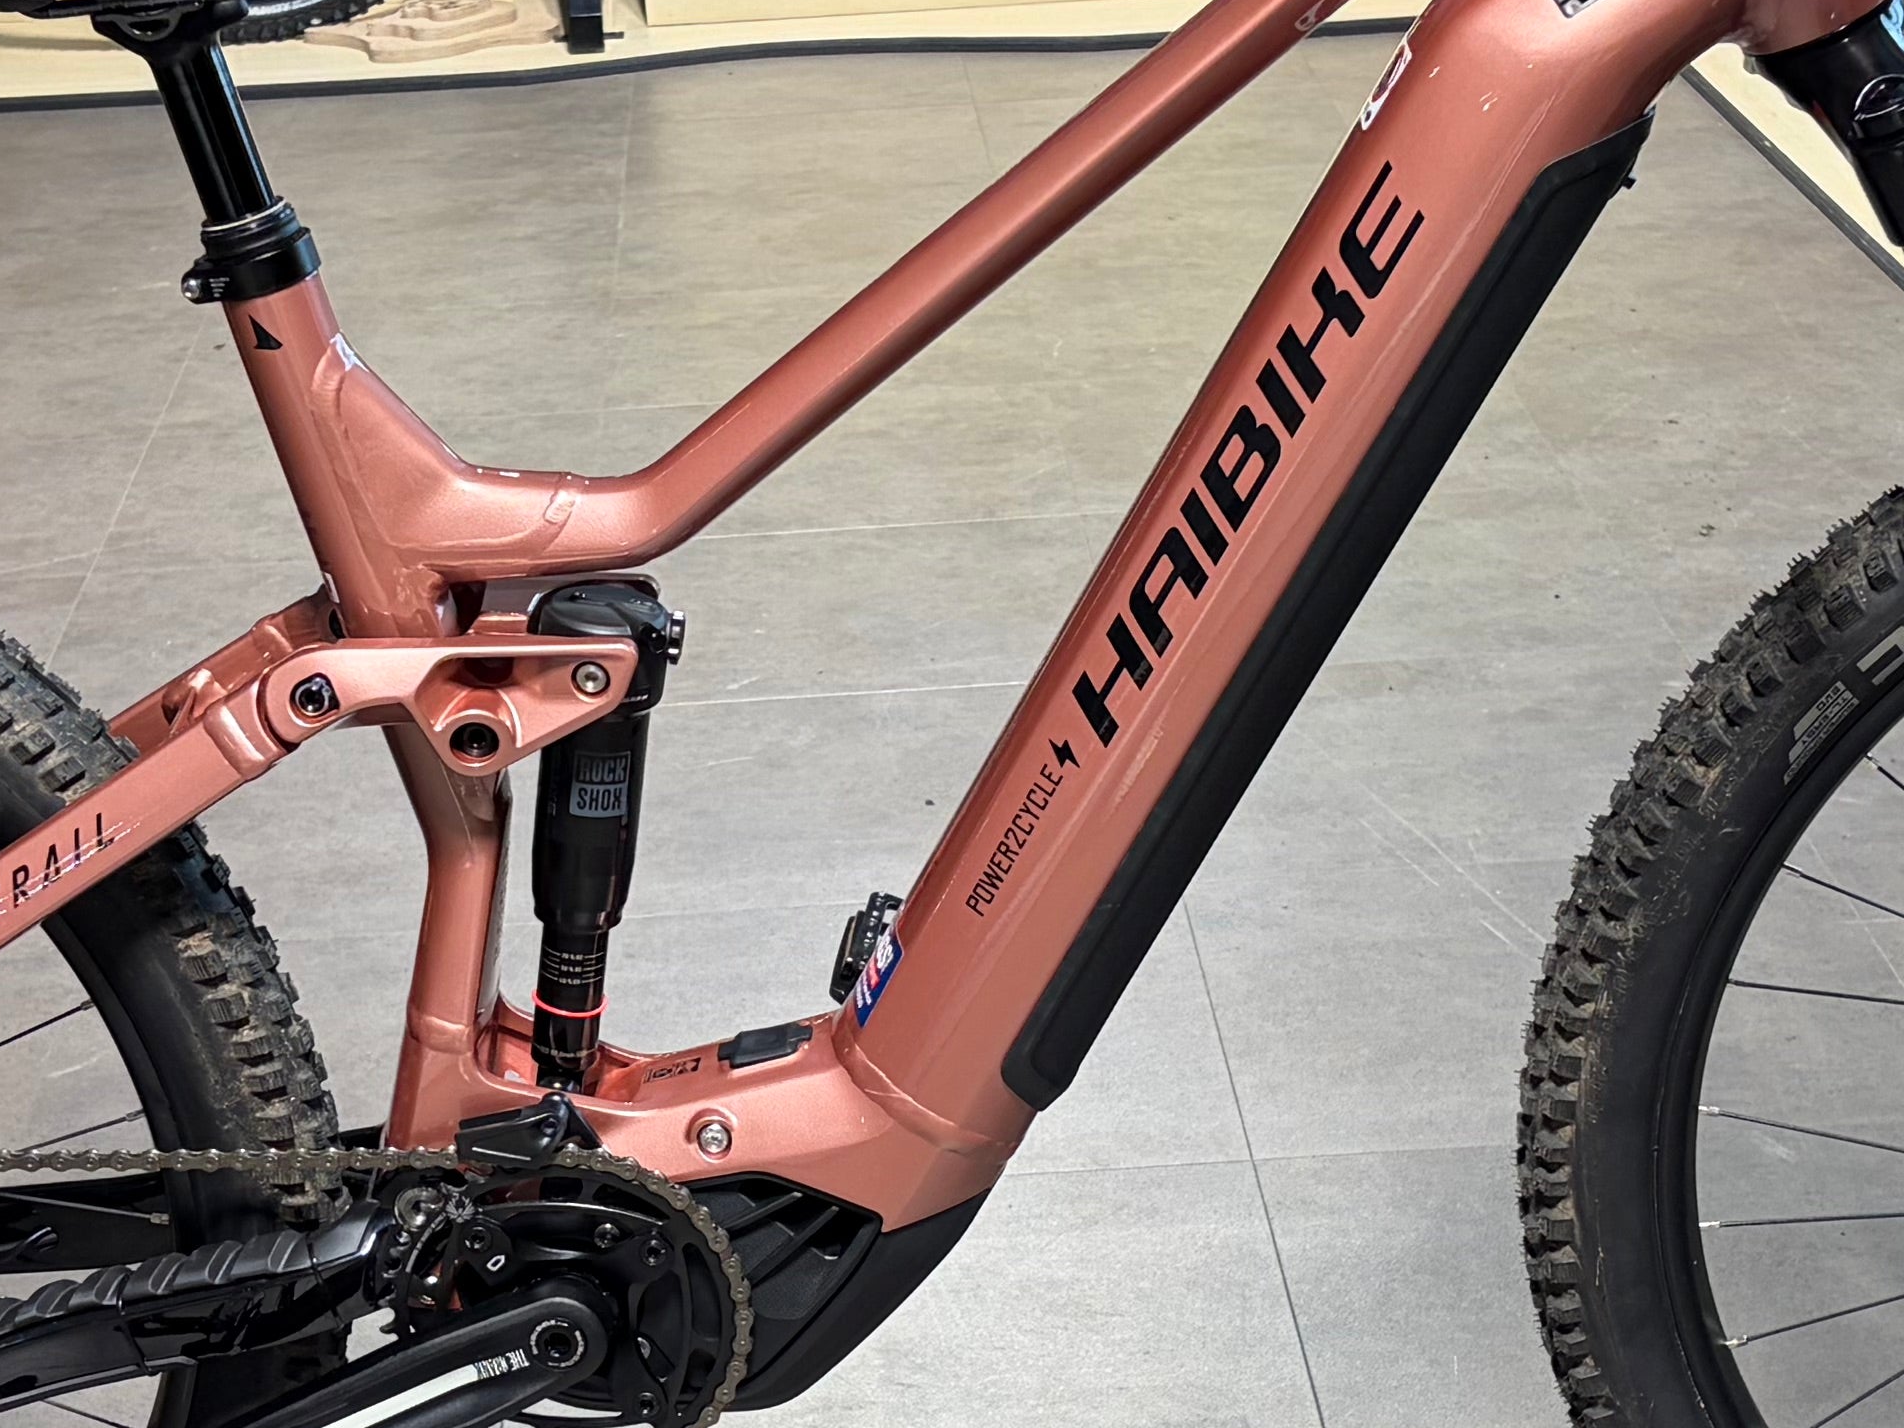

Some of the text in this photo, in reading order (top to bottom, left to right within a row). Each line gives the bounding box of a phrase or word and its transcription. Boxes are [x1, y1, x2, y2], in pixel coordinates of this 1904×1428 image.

[1070, 159, 1426, 749] HAIBIKE
[575, 786, 624, 816] SHOX
[576, 753, 628, 784] ROCK
[965, 760, 1066, 919] POWER2CYCLE
